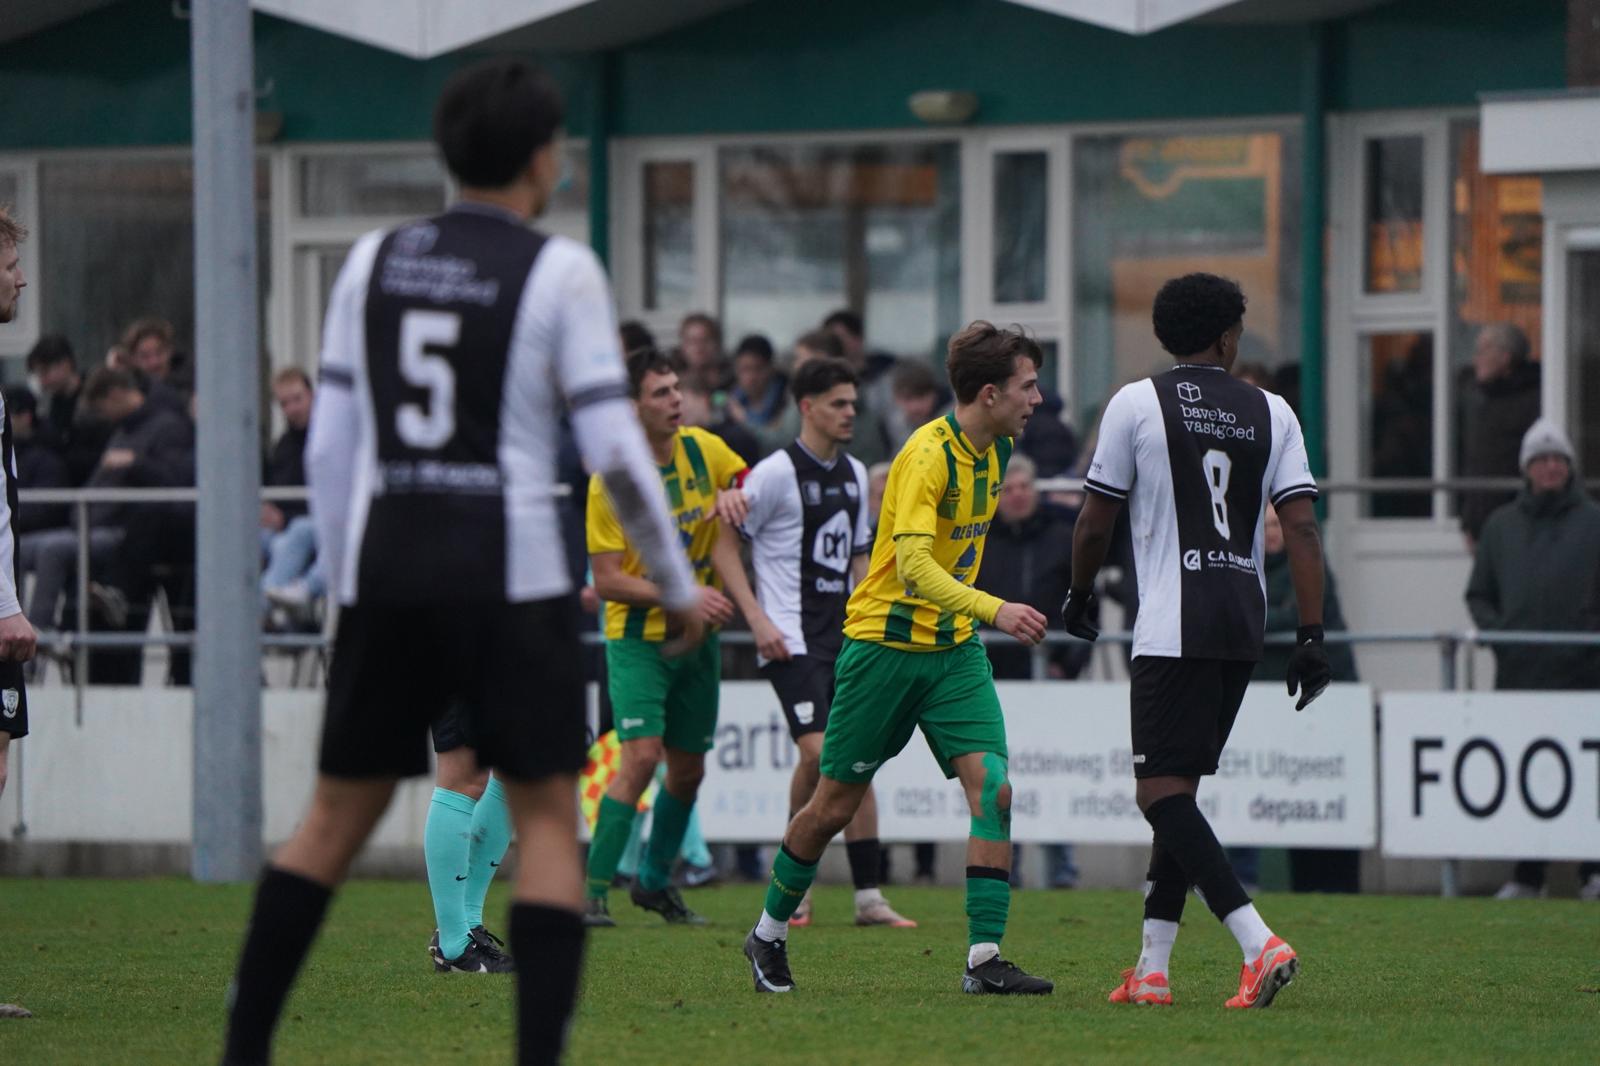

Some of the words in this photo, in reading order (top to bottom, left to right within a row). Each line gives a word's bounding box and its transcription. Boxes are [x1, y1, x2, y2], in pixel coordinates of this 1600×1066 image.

[395, 308, 461, 450] 5
[1180, 404, 1237, 424] baveko
[1183, 420, 1255, 441] vastgoed
[1202, 448, 1232, 541] 8
[715, 711, 793, 771] art
[1248, 790, 1347, 823] depaa.nl
